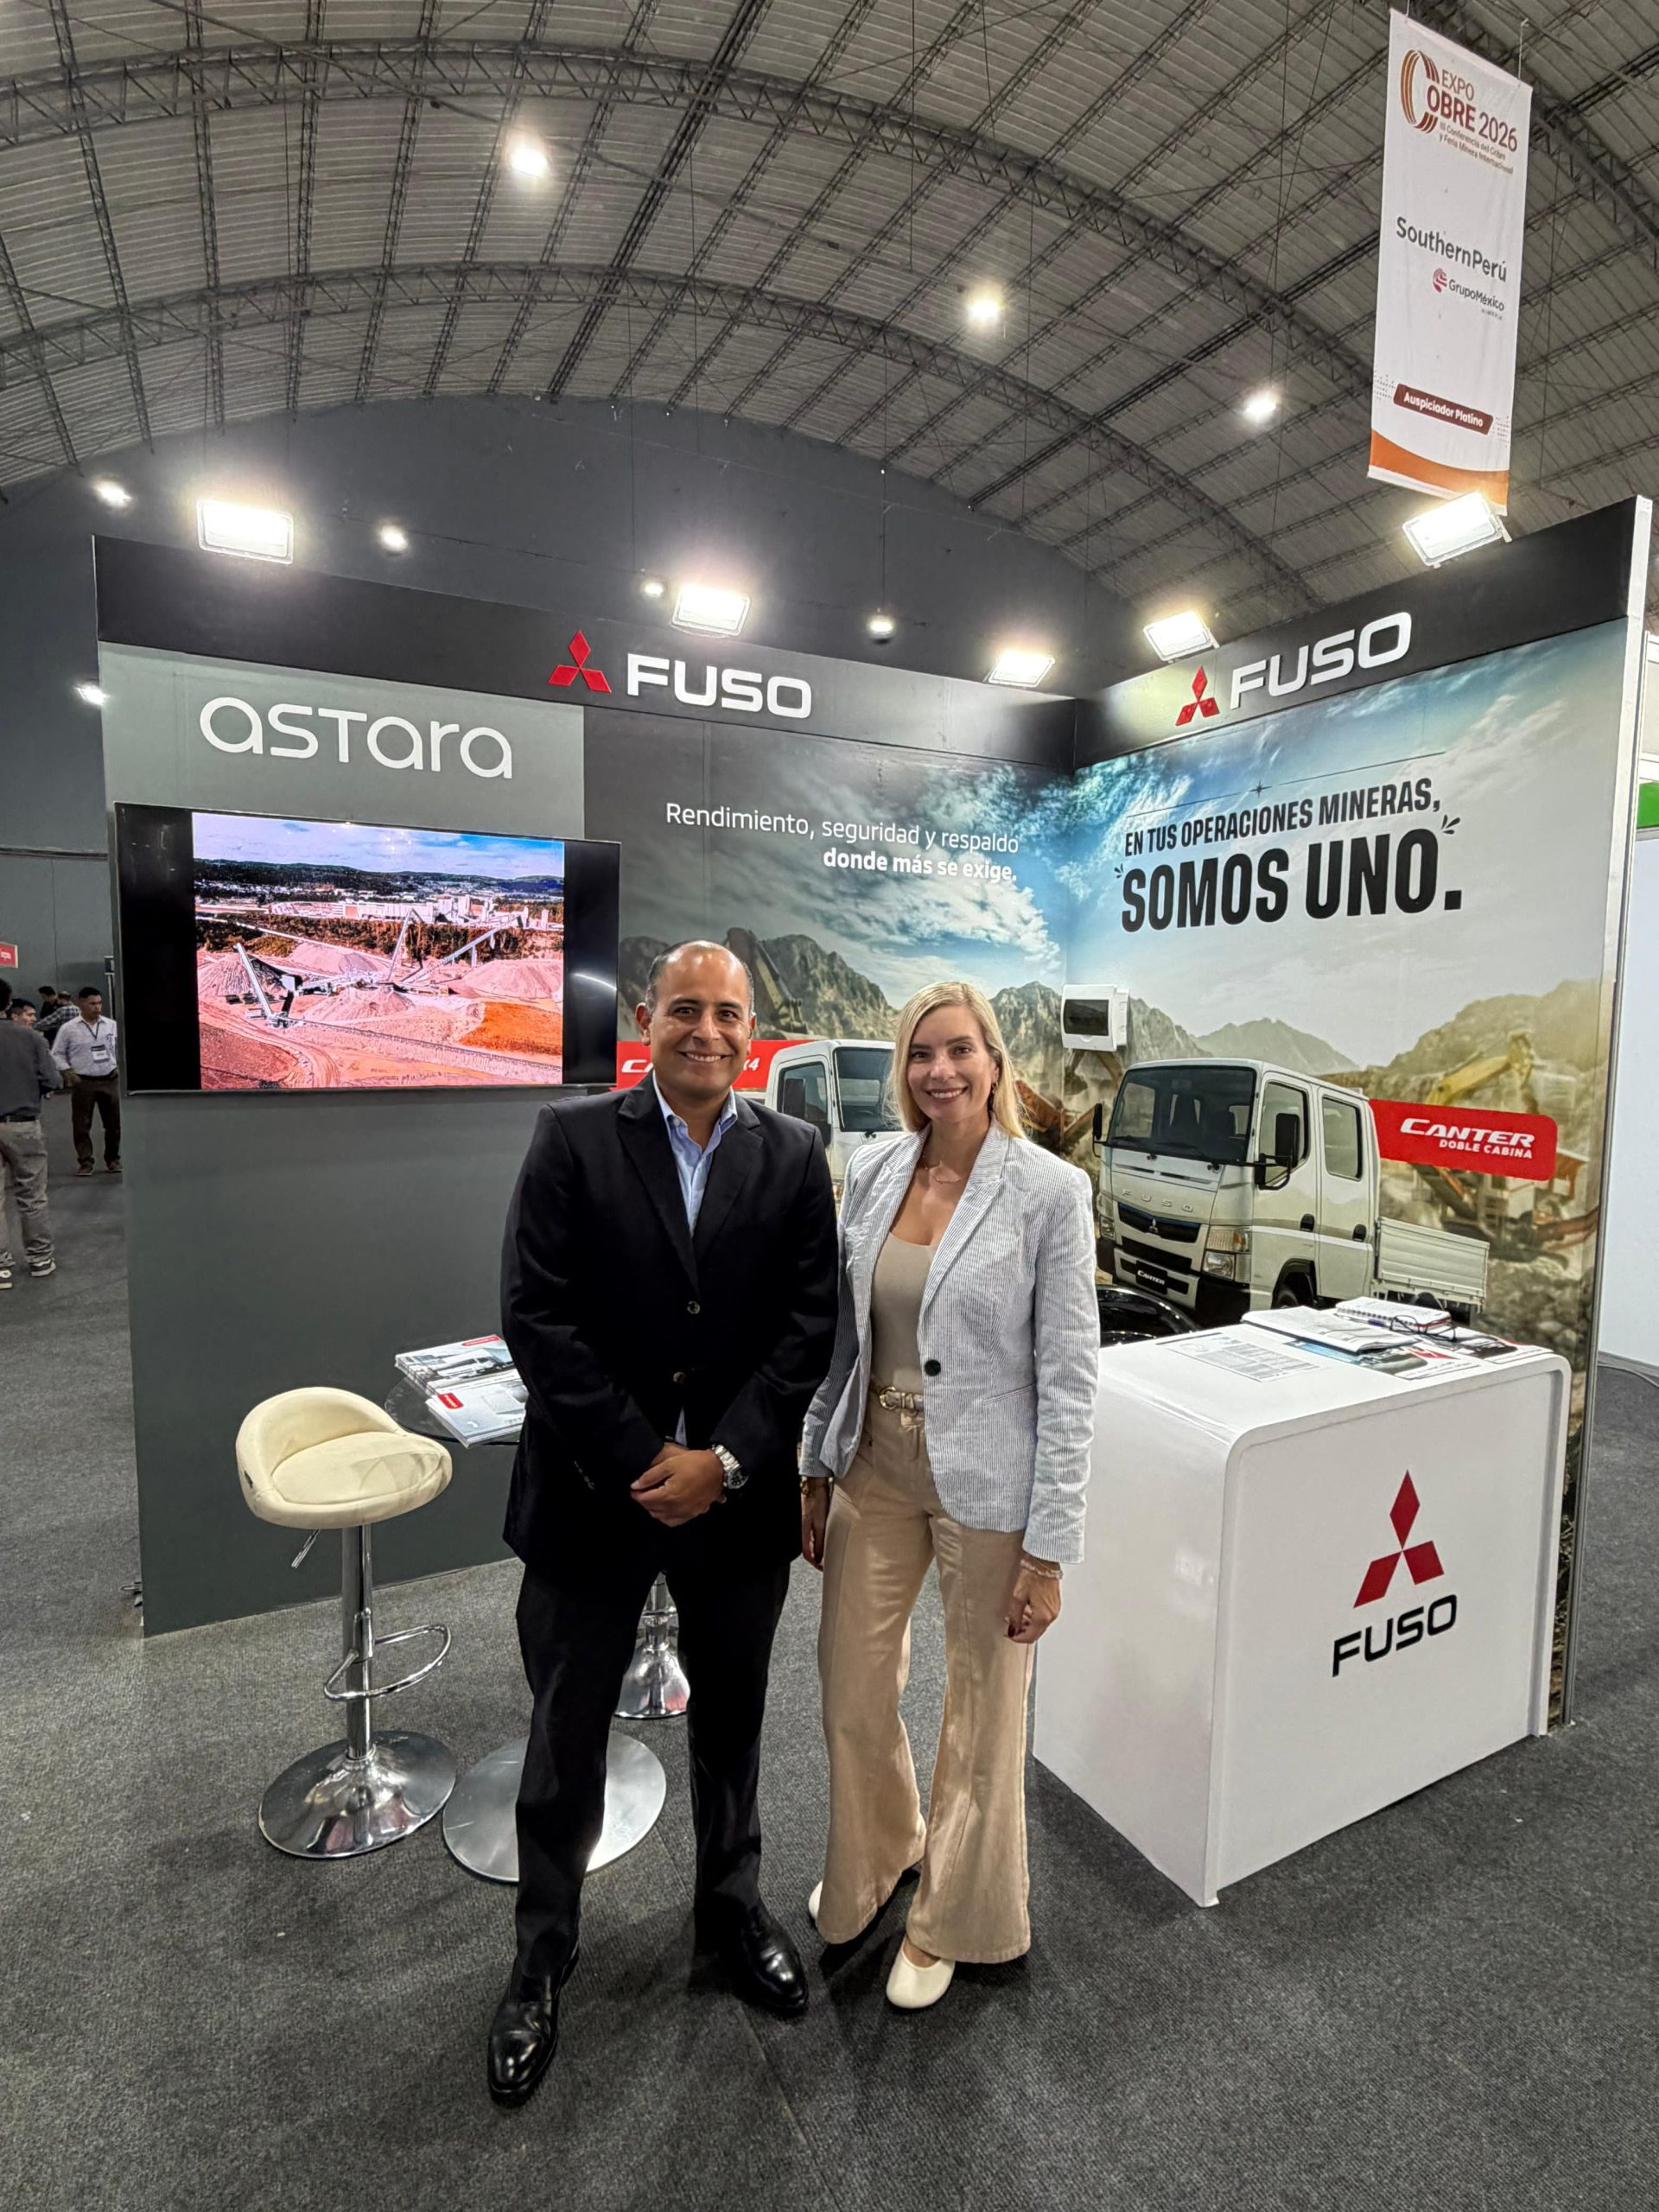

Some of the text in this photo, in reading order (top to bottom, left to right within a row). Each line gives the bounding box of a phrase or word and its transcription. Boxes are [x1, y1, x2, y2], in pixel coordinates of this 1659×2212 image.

[1441, 69, 1474, 101] EXPO
[1479, 111, 1517, 152] 2026
[1403, 391, 1484, 427] Auspiciador Platino
[1230, 612, 1412, 710] FUSO
[626, 652, 812, 719] FUSO
[200, 696, 513, 779] astara
[666, 802, 1019, 854] Rendimiento, seguridad y respaldo
[1125, 777, 1441, 857] EN TUS OPERACIONES MINERAS,
[823, 847, 1017, 883] donde más se exige.
[1122, 829, 1462, 933] SOMOS UNO.
[1400, 1117, 1535, 1147] CANTER
[1439, 1139, 1533, 1159] DOBLE CABINA
[1121, 1189, 1194, 1212] FUSO
[1137, 1269, 1166, 1286] CANTER
[1332, 1593, 1458, 1678] FUSO
